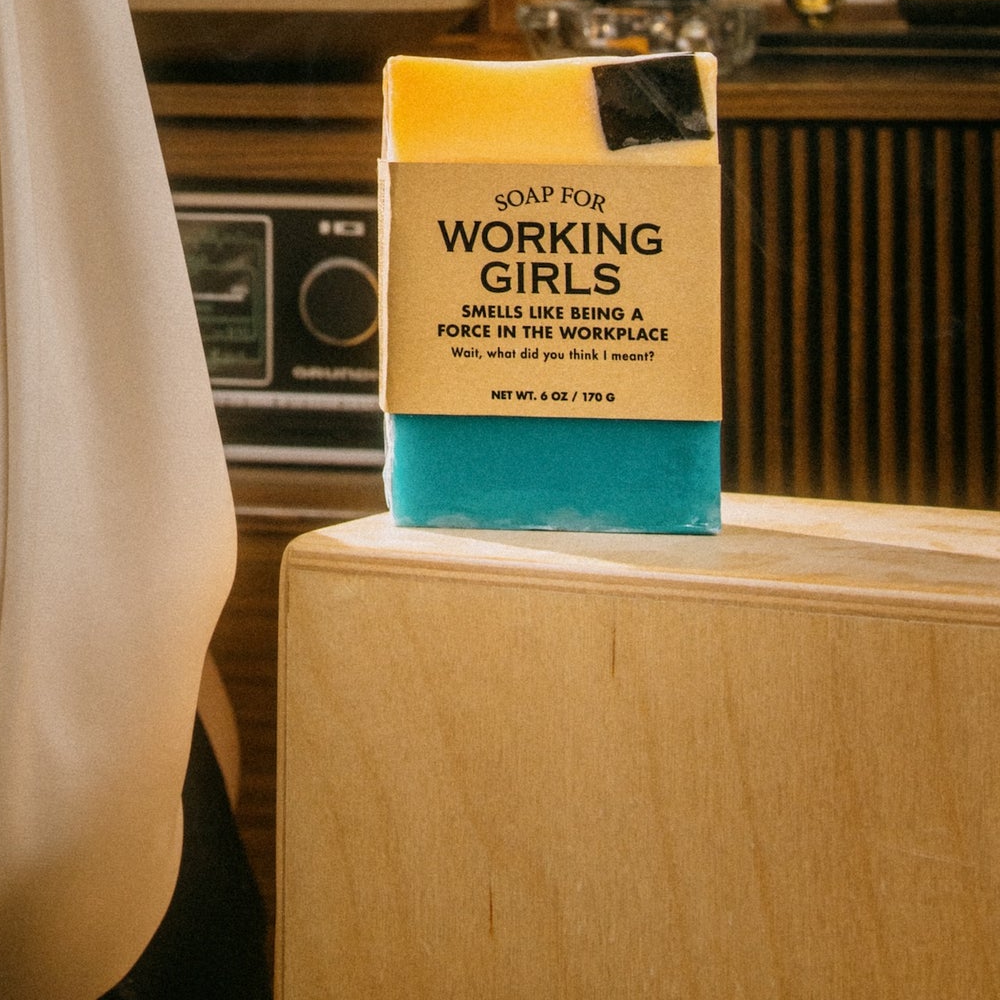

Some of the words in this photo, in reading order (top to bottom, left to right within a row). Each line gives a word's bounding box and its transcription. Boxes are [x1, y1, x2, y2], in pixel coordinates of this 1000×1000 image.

[495, 186, 554, 211] SOAP
[561, 187, 605, 213] FOR
[437, 220, 663, 255] WORKING
[481, 261, 620, 295] GIRLS
[461, 304, 523, 320] SMELLS
[529, 305, 564, 320] LIKE
[570, 306, 625, 322] BEING
[630, 307, 644, 322] A
[437, 323, 491, 339] FORCE
[497, 324, 517, 339] IN
[521, 325, 554, 340] THE
[558, 325, 669, 342] WORKPLACE
[450, 346, 483, 360] Wait,
[486, 346, 516, 359] what
[519, 347, 539, 360] did
[542, 351, 565, 363] you
[568, 347, 599, 361] think
[603, 349, 607, 361] I
[611, 350, 655, 362] meant?
[491, 390, 513, 401] NET
[515, 390, 537, 401] WT.
[540, 391, 549, 401] 6
[550, 391, 569, 402] OZ
[571, 391, 578, 403] /
[582, 391, 603, 403] 170
[605, 392, 616, 403] G
